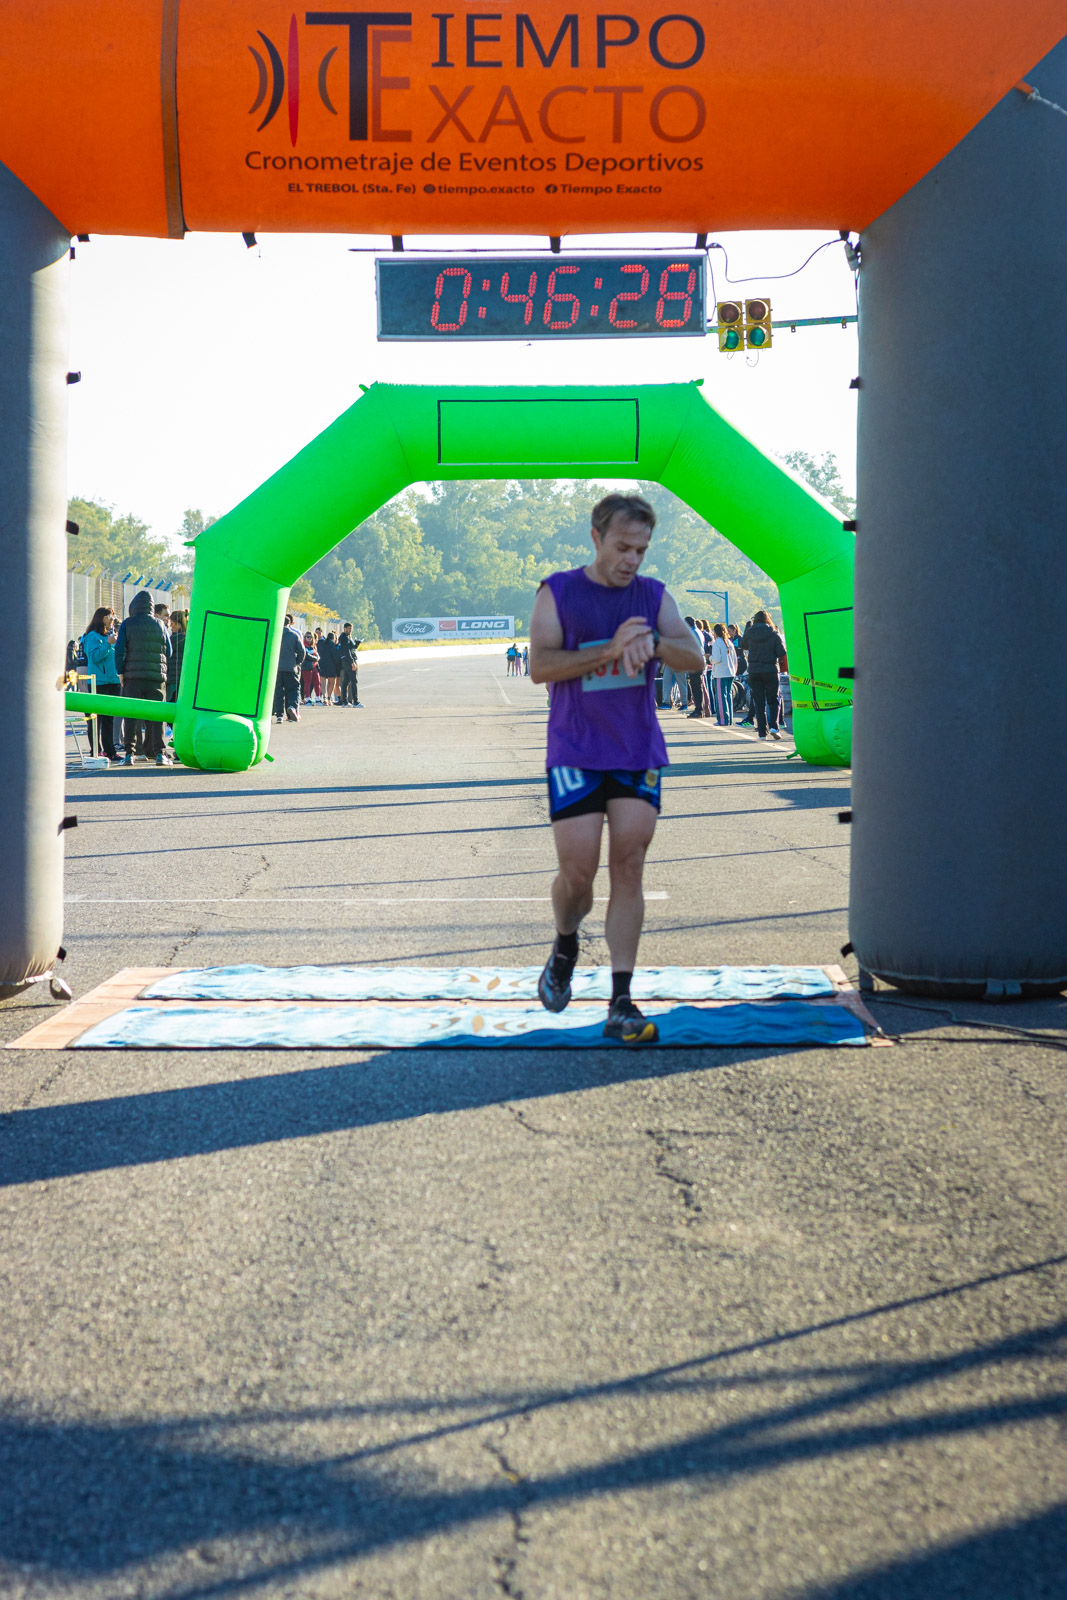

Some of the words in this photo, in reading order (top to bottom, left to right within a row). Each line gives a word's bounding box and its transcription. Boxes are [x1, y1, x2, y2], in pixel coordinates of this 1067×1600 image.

[245, 151, 413, 175] Cronometraje
[421, 152, 451, 172] de
[459, 153, 557, 172] Eventos
[566, 152, 704, 175] Deportivos
[288, 183, 304, 193] EL
[306, 183, 359, 193] TREBOL
[362, 183, 393, 194] (Sta.
[396, 183, 416, 194] Fe)
[560, 184, 613, 195] Tiempo
[616, 184, 662, 194] Exacto
[431, 263, 696, 332] 0:46:28
[402, 622, 427, 634] Ford
[461, 621, 506, 629] LONG
[551, 766, 585, 797] 10
